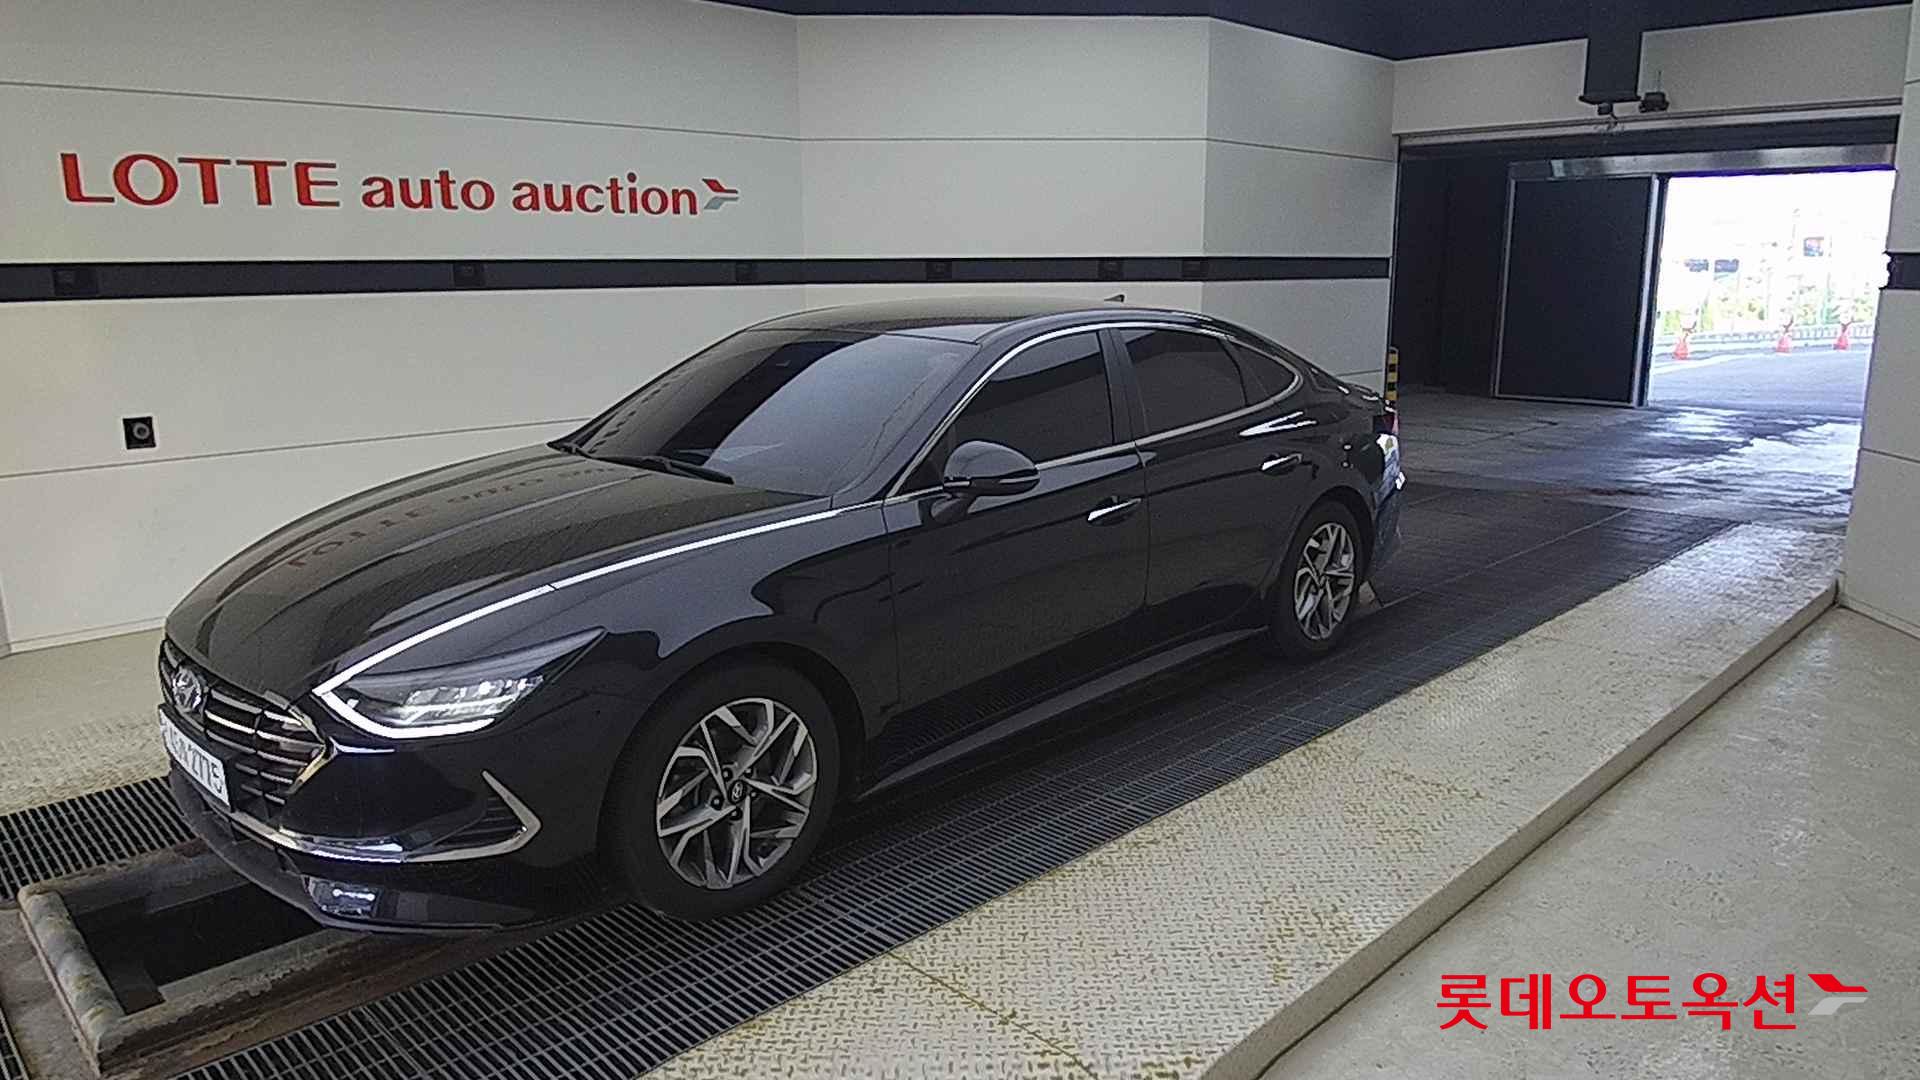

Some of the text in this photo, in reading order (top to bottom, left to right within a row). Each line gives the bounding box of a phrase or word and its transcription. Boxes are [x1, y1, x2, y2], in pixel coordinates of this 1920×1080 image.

[60, 152, 698, 216] LOTTE auto auction
